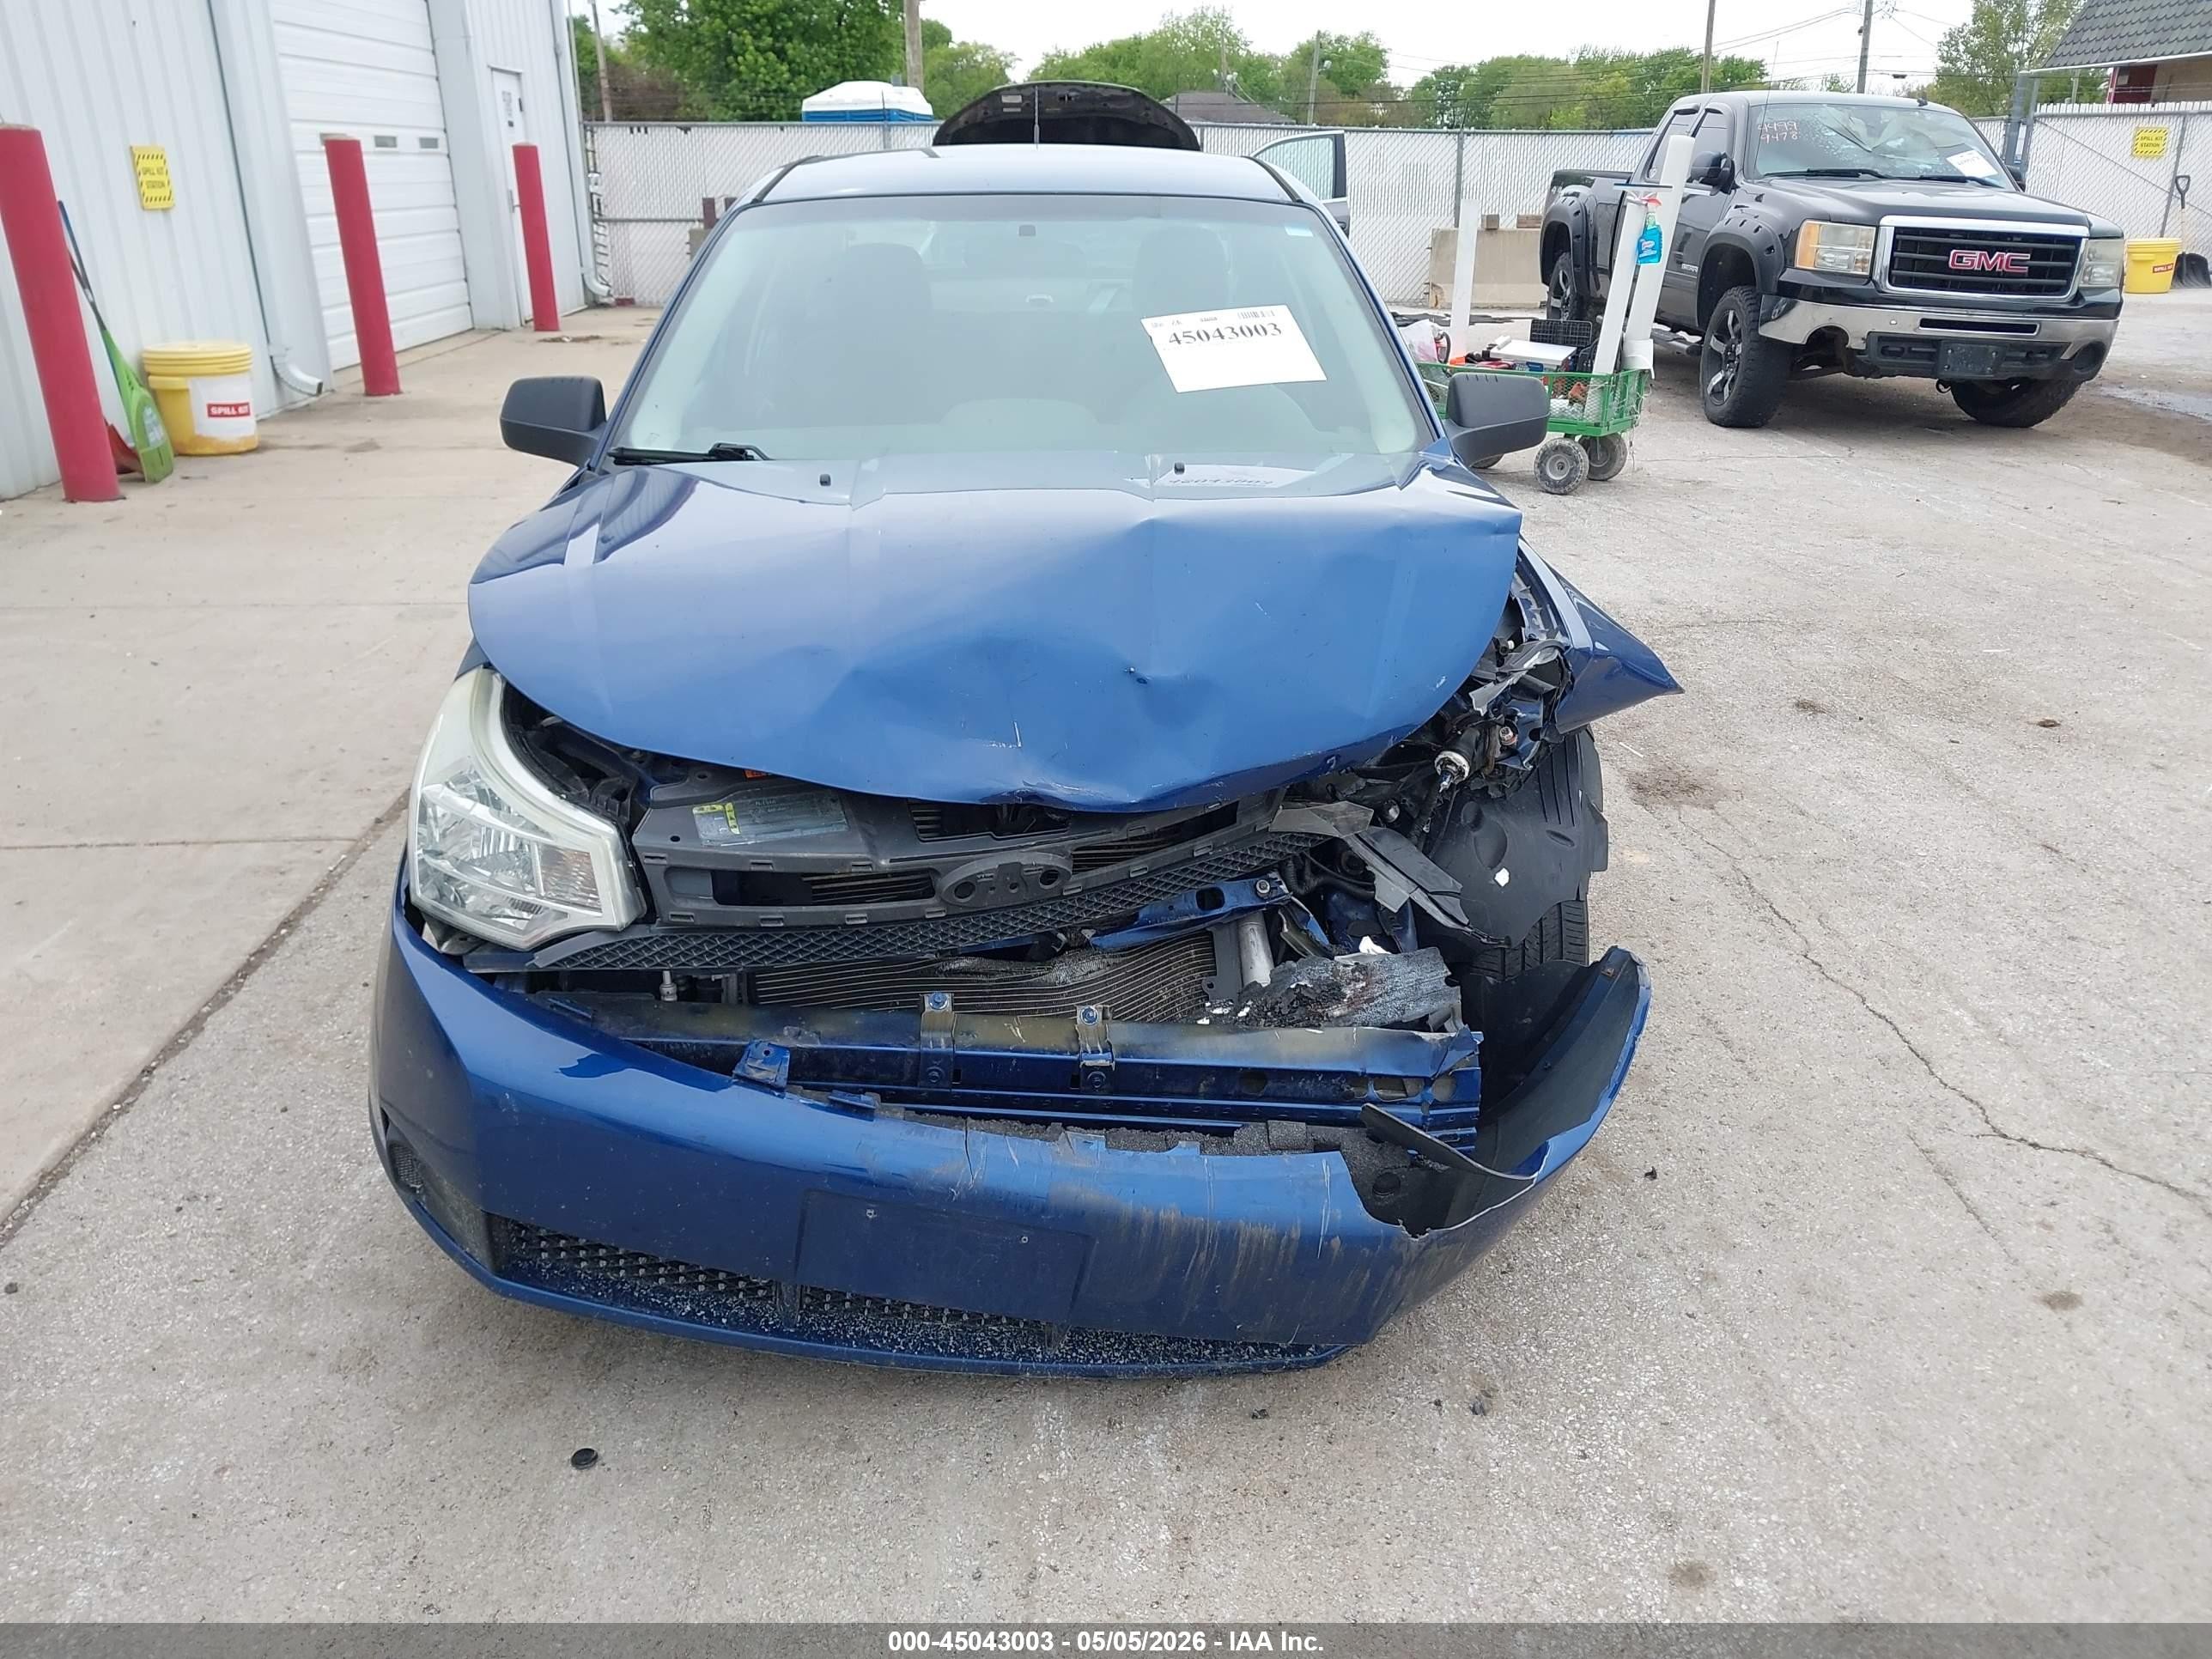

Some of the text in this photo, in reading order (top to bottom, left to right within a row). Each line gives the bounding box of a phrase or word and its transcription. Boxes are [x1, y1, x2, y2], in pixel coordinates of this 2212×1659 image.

[1948, 249, 2031, 272] GMC
[1168, 322, 1282, 345] 45043003
[210, 405, 237, 416] SPILL
